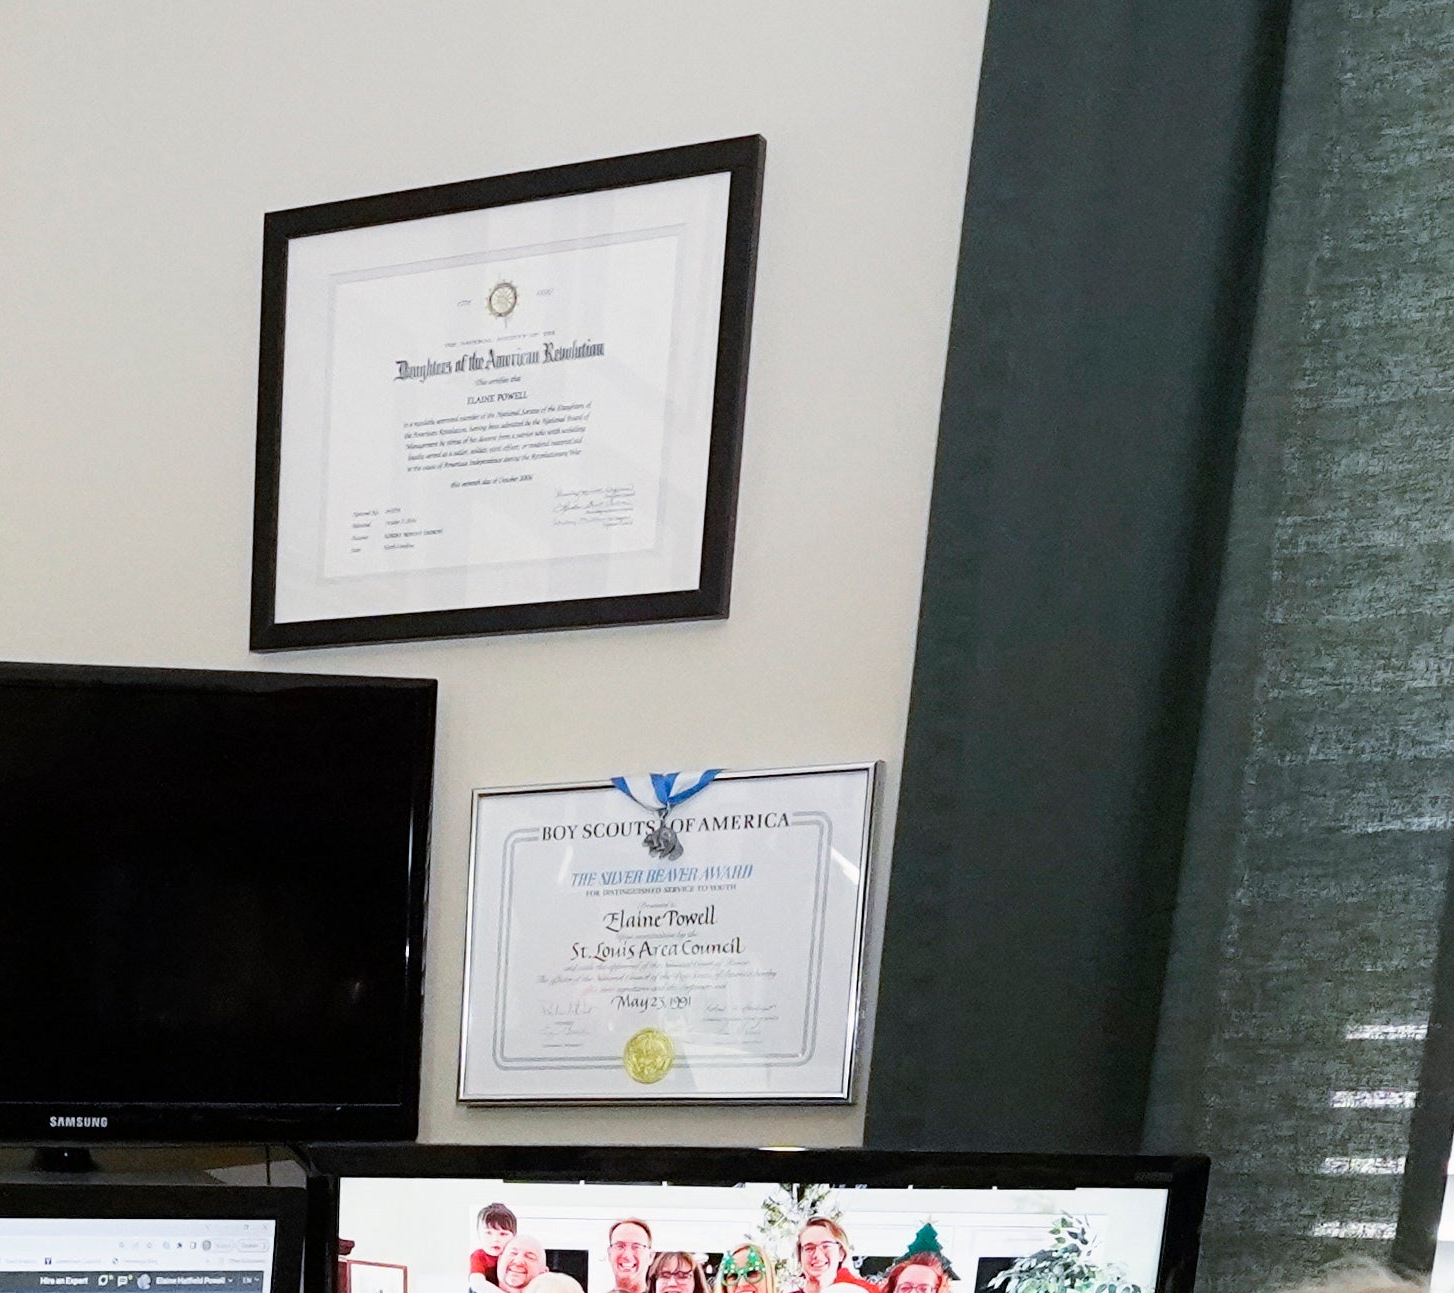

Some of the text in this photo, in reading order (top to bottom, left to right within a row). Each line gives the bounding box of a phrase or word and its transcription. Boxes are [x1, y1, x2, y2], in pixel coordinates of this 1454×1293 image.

[394, 357, 453, 383] Daughters
[485, 346, 540, 370] American
[542, 339, 606, 365] Revolution
[466, 390, 528, 406] ELAINE POWELL
[541, 812, 791, 842] BOY SCOUTS OF AMERICA
[571, 864, 755, 888] THE SILVER BEAVER AWARD
[603, 904, 717, 933] Elaine Powell
[570, 936, 745, 963] St. Louis Area Council
[610, 994, 649, 1014] May
[49, 1115, 108, 1128] SAMSUNG
[40, 1276, 55, 1285] Hire
[65, 1276, 89, 1286] Expert
